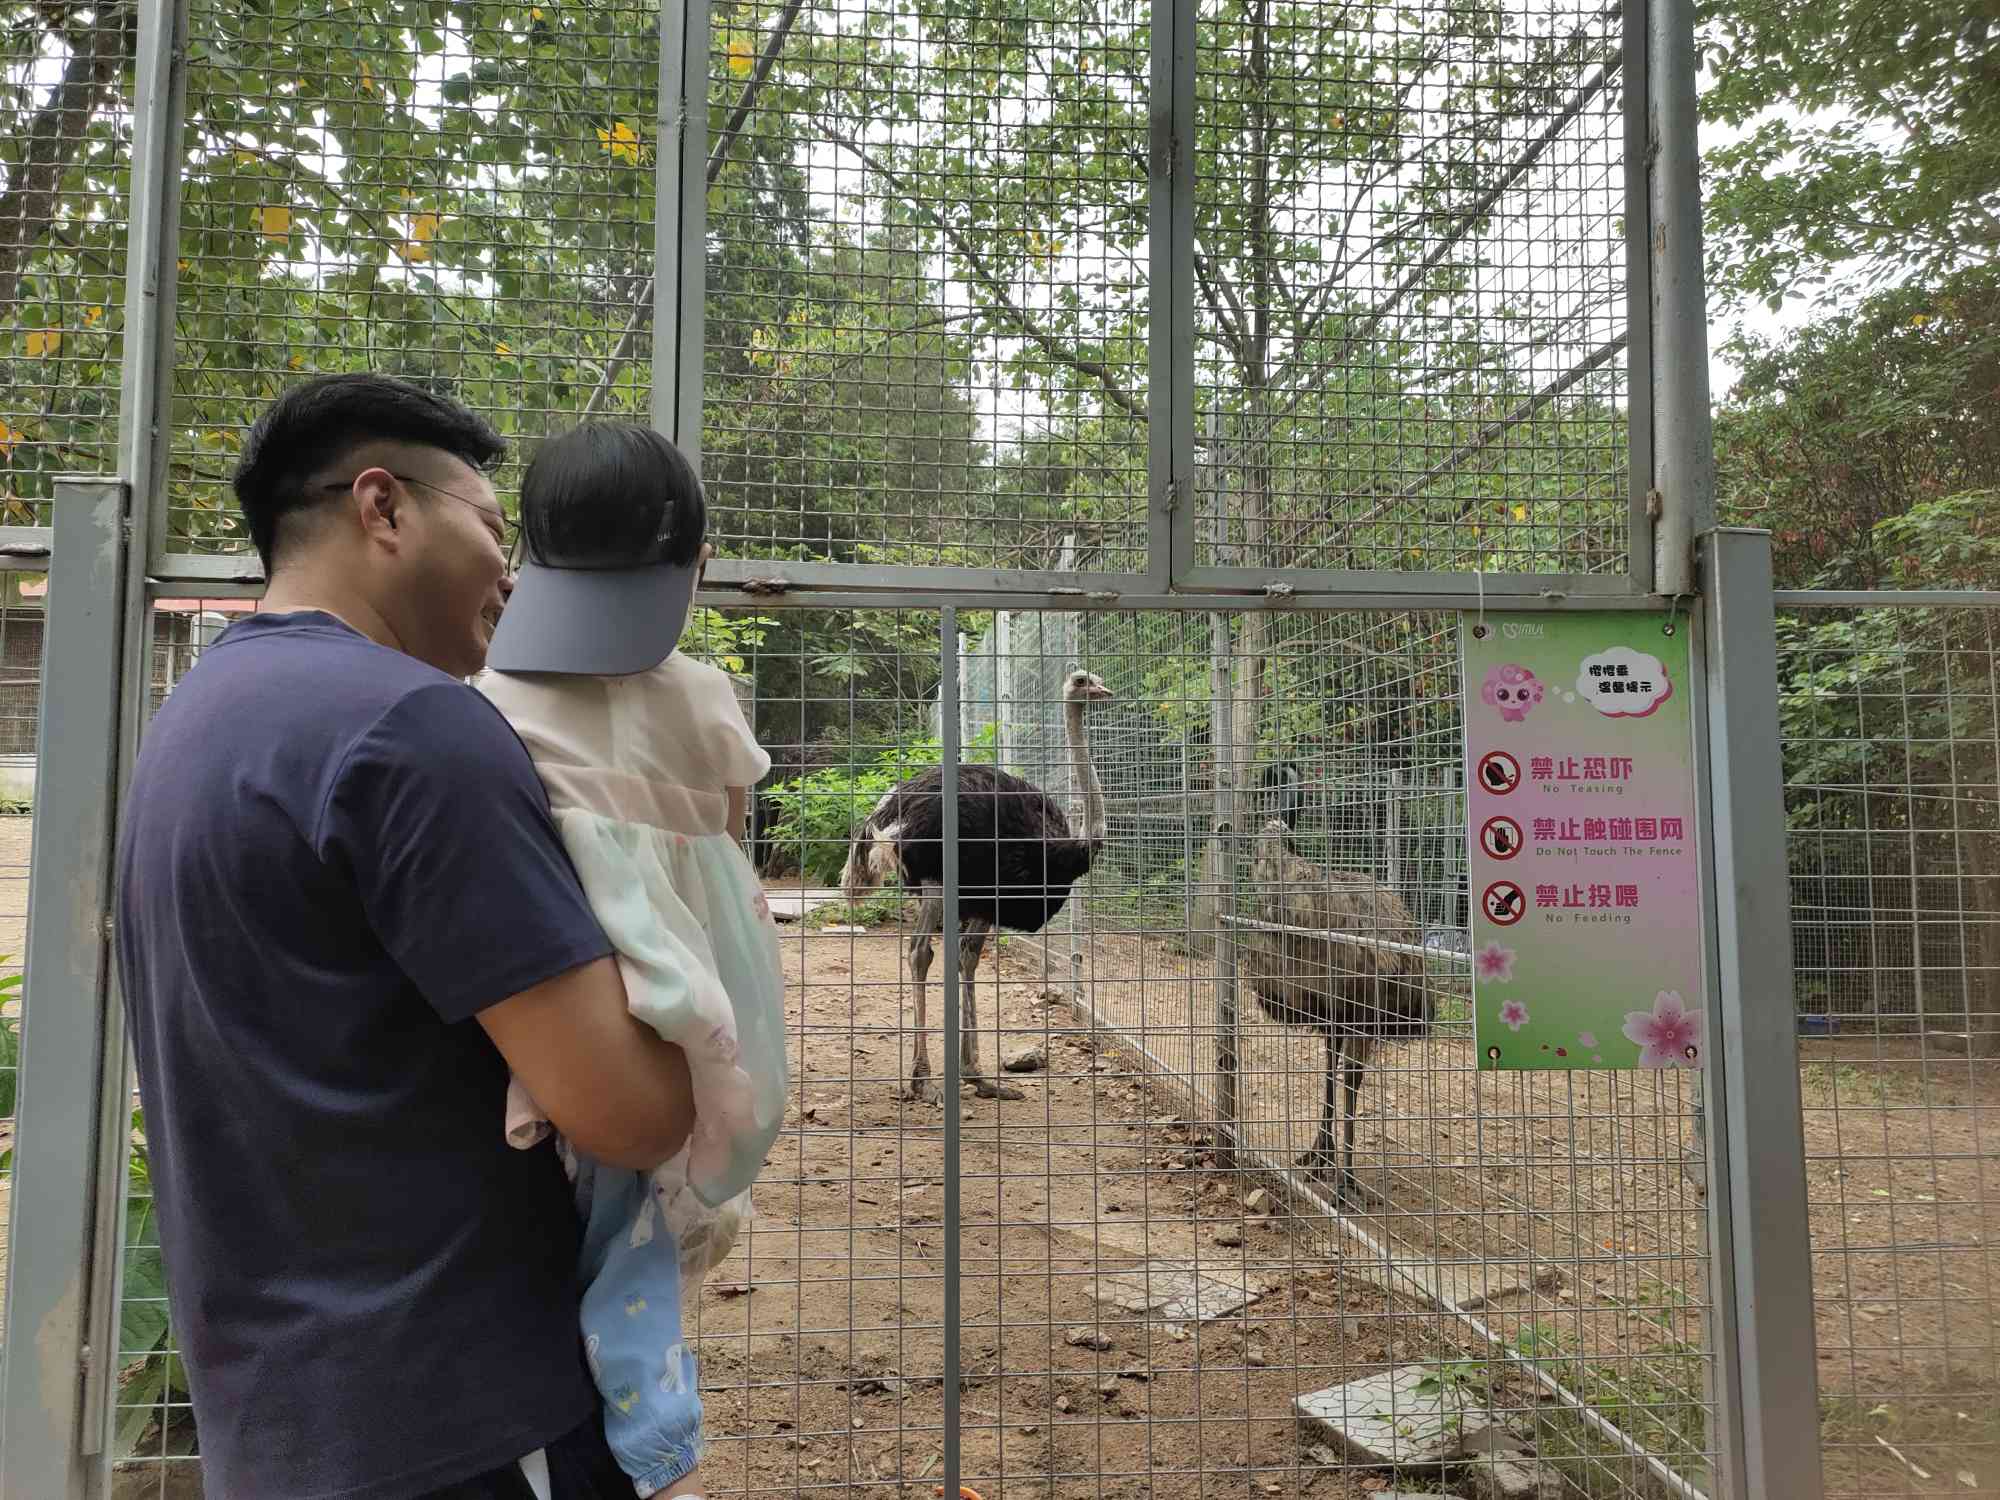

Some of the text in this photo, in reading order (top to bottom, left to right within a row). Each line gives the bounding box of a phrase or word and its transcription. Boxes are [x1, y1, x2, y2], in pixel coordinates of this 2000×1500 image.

[1530, 756, 1633, 781] 禁止恐吓
[1543, 784, 1624, 795] No Teasing
[1532, 817, 1684, 841] 禁止触碰围网
[1535, 846, 1683, 856] Do Not Touch The Fence
[1535, 884, 1640, 909] 禁止投喂
[1546, 913, 1633, 925] No Feeding
